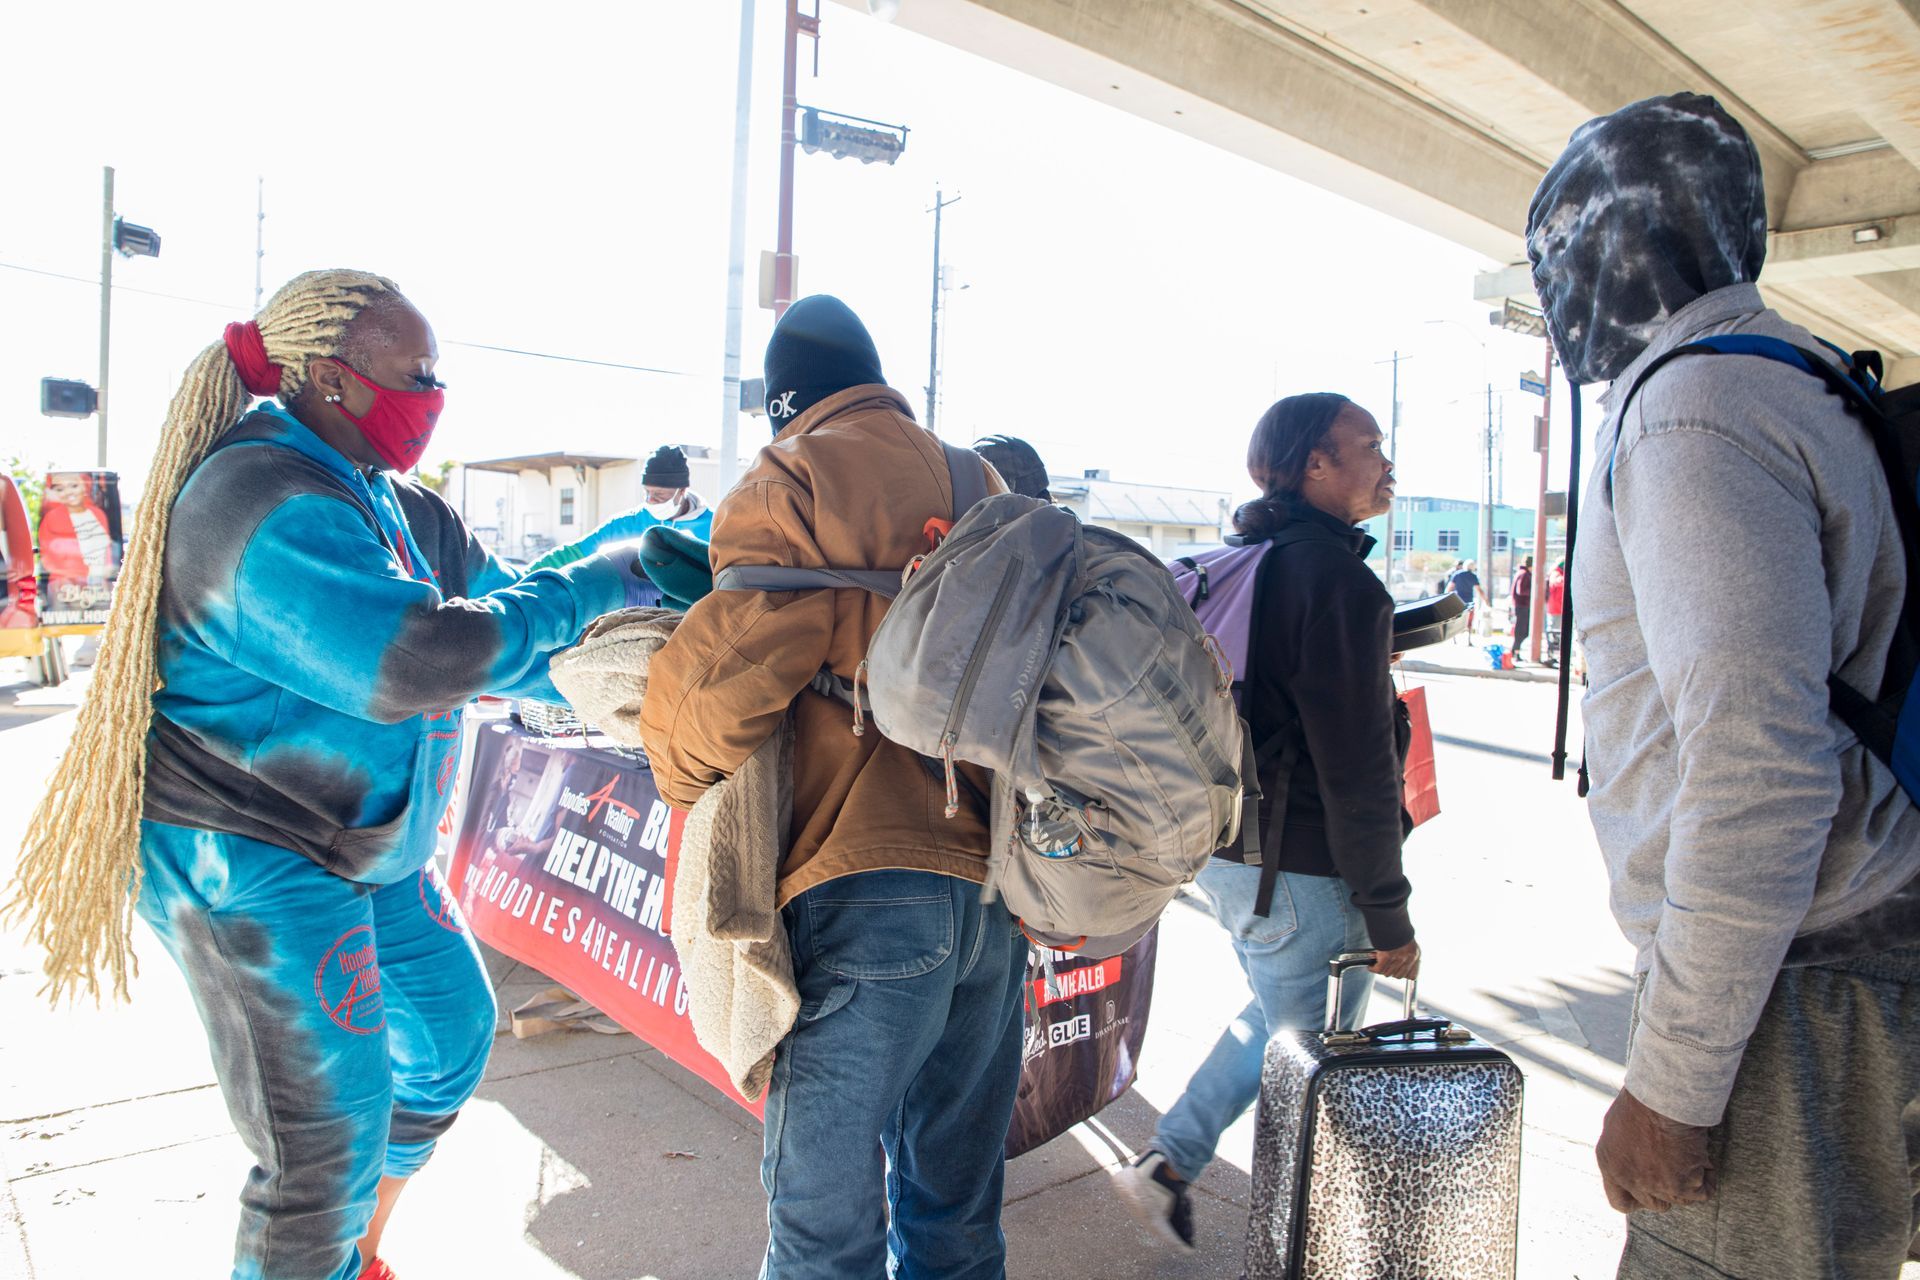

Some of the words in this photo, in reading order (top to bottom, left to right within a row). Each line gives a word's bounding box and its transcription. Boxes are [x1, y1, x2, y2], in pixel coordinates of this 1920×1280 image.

[769, 390, 798, 419] OK
[558, 786, 591, 816] Hoodies
[543, 827, 611, 894] HELP
[603, 852, 648, 920] THE
[1051, 1017, 1087, 1044] GLUE
